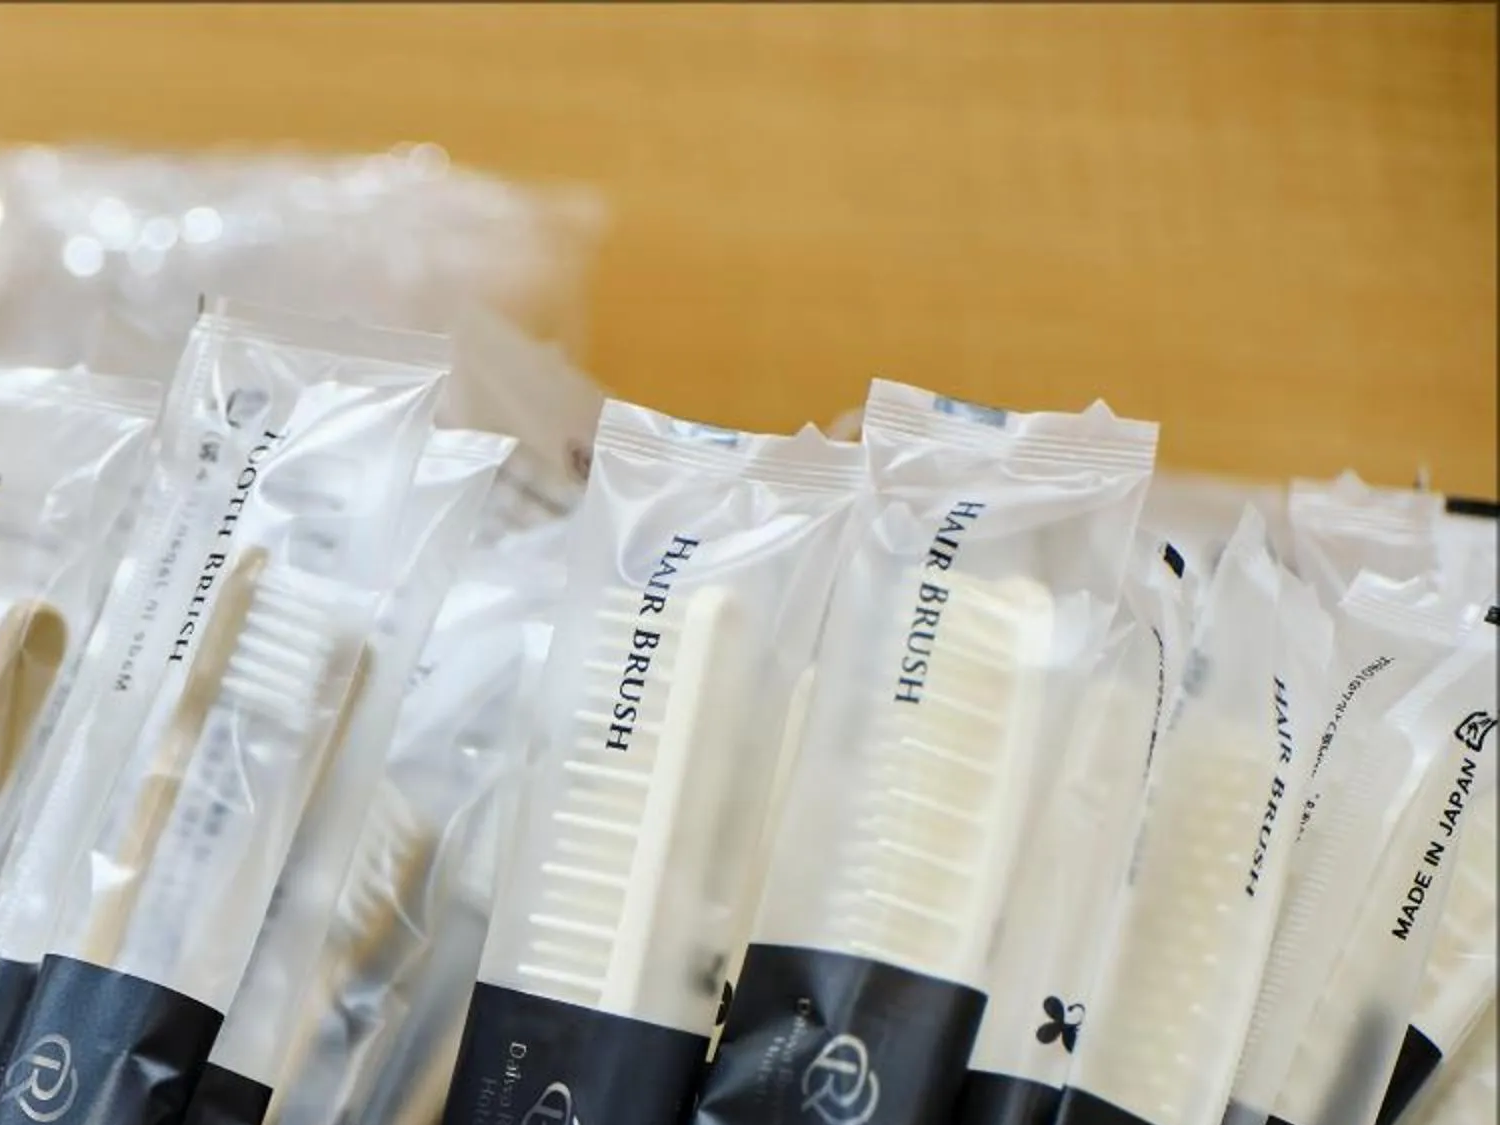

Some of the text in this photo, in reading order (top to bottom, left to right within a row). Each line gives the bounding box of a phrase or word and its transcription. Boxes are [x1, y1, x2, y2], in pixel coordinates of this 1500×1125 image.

[605, 534, 700, 752] HAIR BRUSH
[893, 501, 986, 705] HAIR BRUSH
[1245, 675, 1294, 897] HAIR BRUSH
[1392, 758, 1478, 941] MADE IN JAPAN
